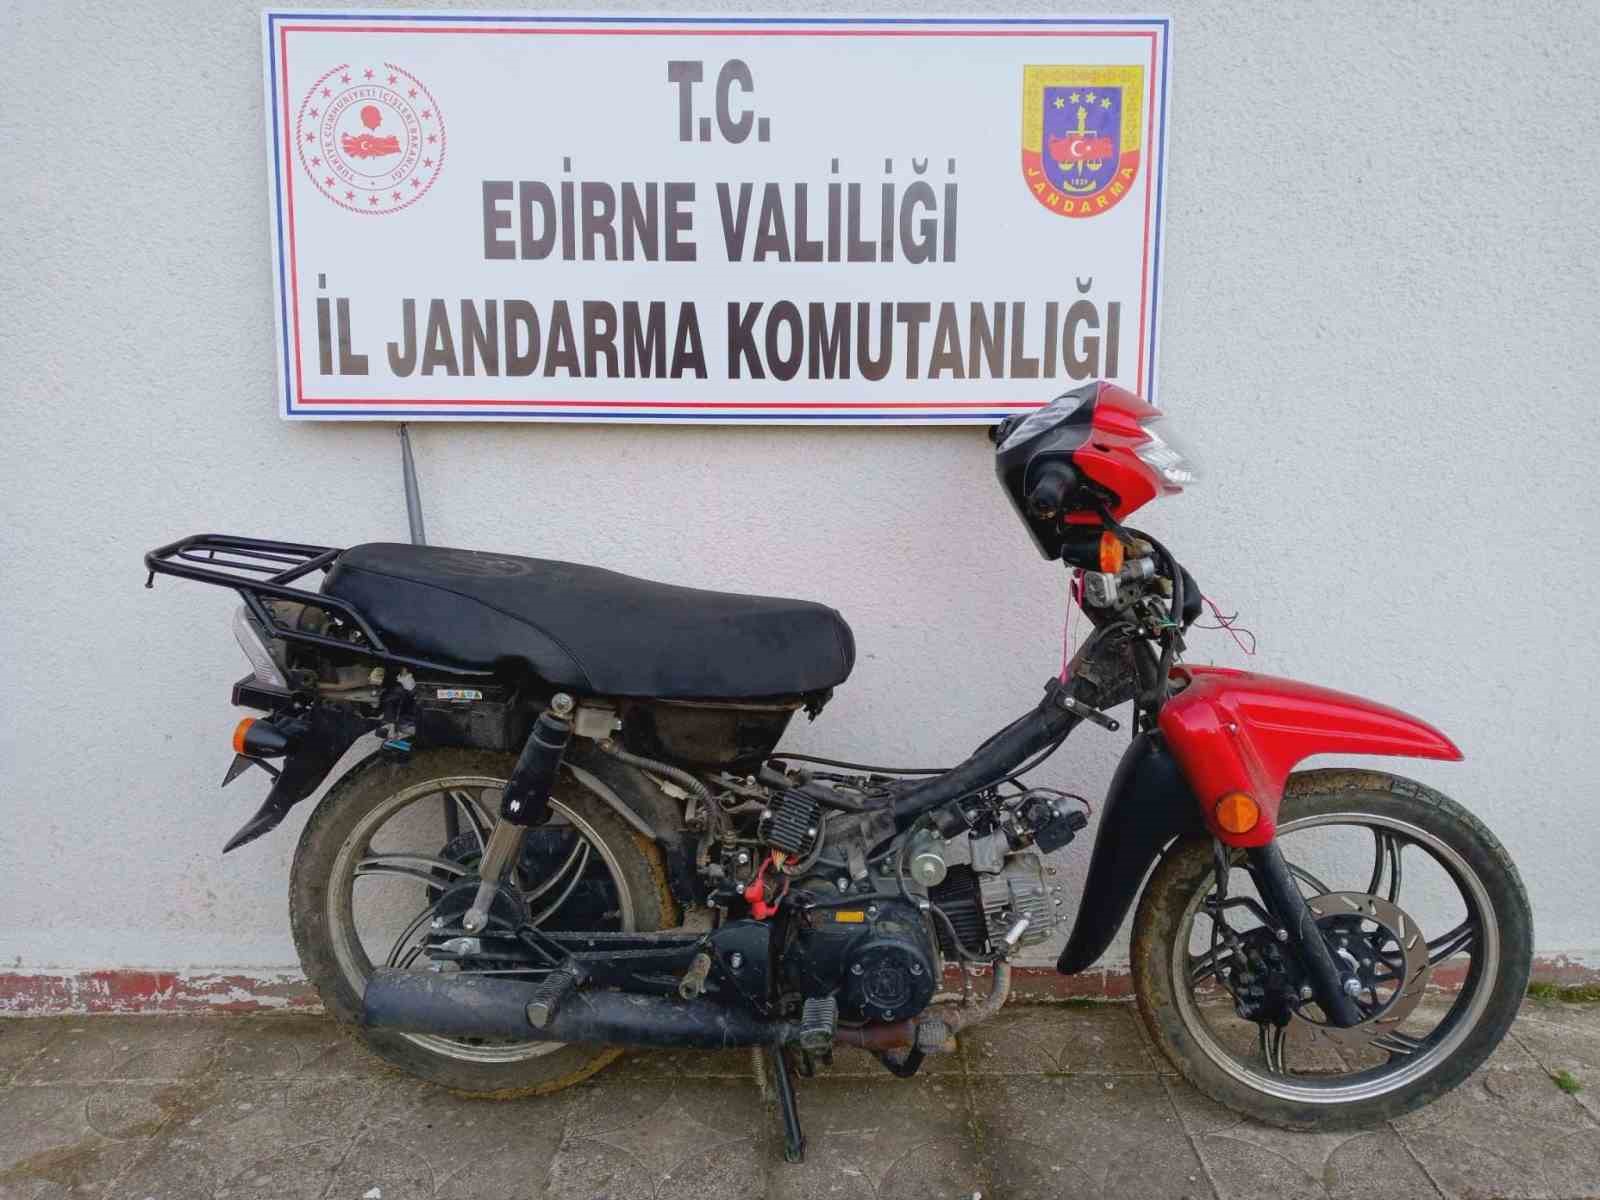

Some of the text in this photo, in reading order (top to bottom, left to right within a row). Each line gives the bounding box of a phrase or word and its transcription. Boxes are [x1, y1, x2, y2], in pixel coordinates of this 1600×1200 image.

[667, 58, 770, 144] T.C.
[483, 156, 958, 263] EDİRNE VALİLİĞİ
[1027, 167, 1135, 213] JANDARMA
[317, 273, 1121, 381] İL JANDARMA KOMUTANLIĞI
